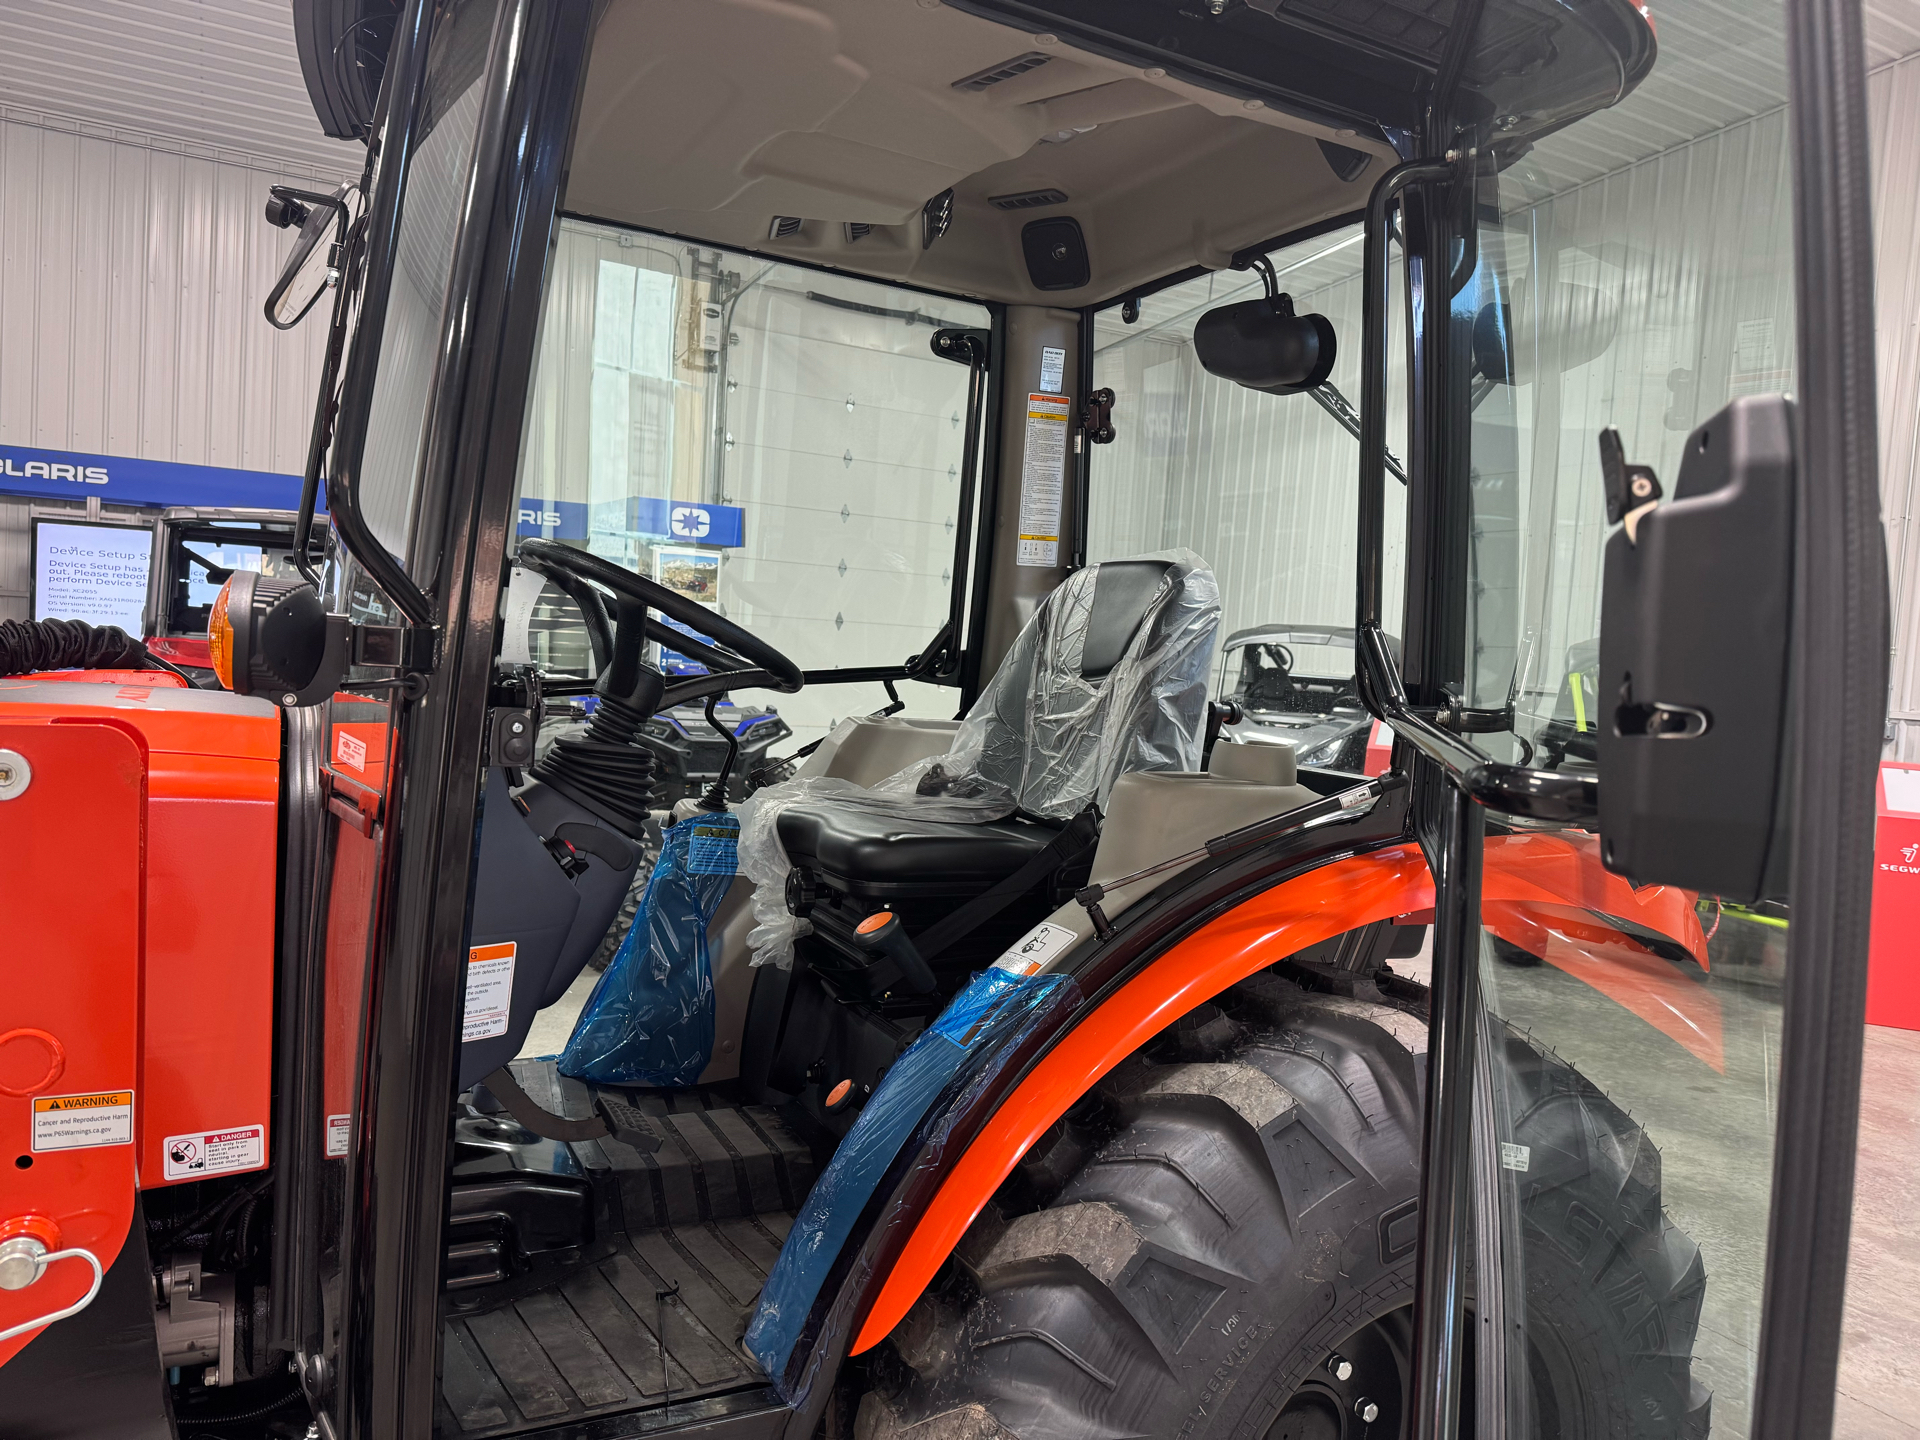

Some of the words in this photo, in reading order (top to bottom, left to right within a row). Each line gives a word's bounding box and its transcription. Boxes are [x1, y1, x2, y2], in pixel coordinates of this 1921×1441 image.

[0, 458, 109, 485] LARIS
[50, 546, 94, 557] Device
[98, 550, 136, 560] Setup
[49, 560, 86, 568] Device
[90, 563, 121, 572] Setup
[74, 569, 109, 578] Please
[112, 572, 147, 580] reboot
[49, 576, 92, 584] perform
[96, 578, 132, 587] Device
[63, 1096, 118, 1108] WARNING
[73, 1115, 111, 1124] Reproductive
[37, 1127, 112, 1138] www.P65Warnings.ca.gov
[221, 1131, 252, 1141] DANGER
